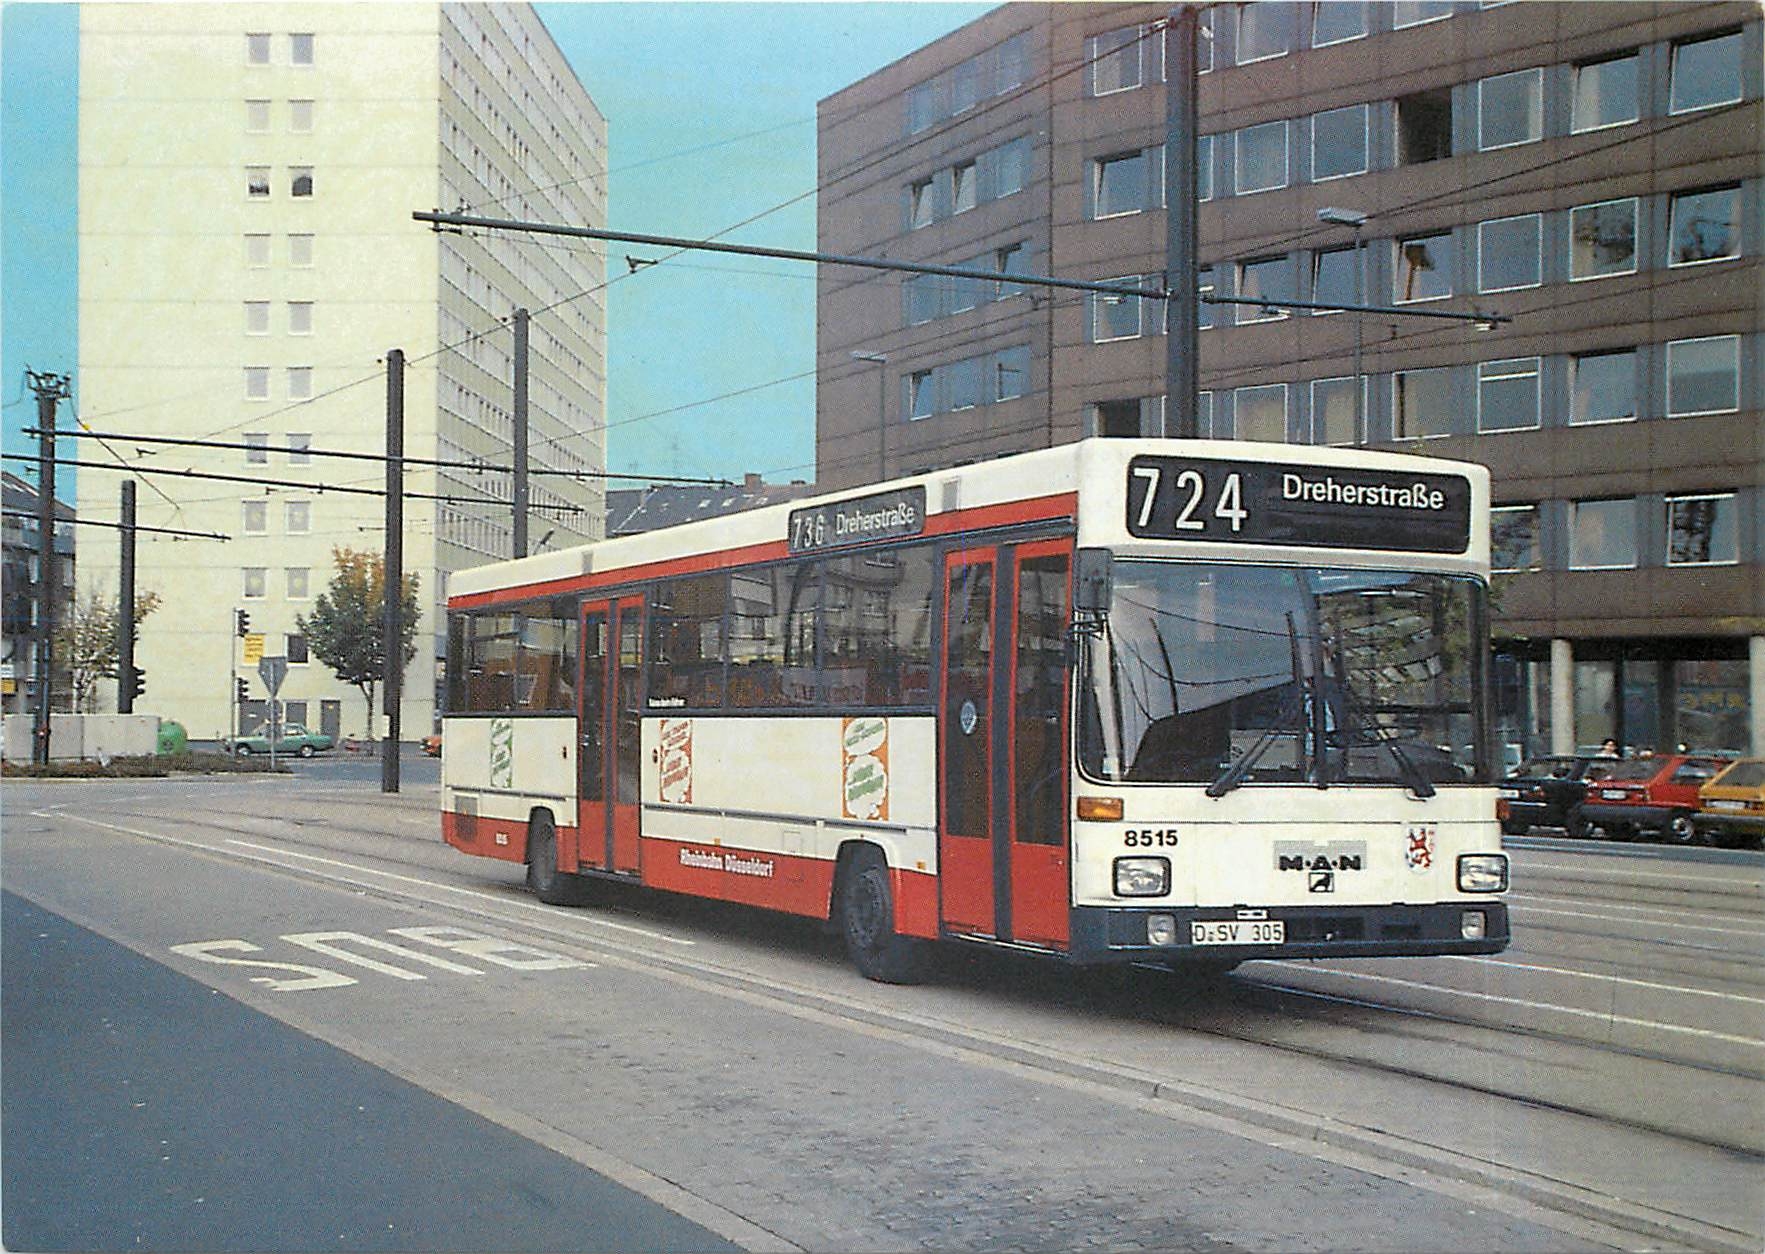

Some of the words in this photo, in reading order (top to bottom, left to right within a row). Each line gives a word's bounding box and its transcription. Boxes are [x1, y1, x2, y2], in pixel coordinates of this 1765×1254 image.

[1133, 467, 1247, 532] 724
[1282, 473, 1445, 510] Dreherstraße
[836, 502, 916, 535] Dreherstraße
[1124, 829, 1178, 847] 8515
[680, 848, 723, 871] Rheinbahn
[725, 854, 772, 878] Düsseldorf
[1252, 924, 1282, 941] 305
